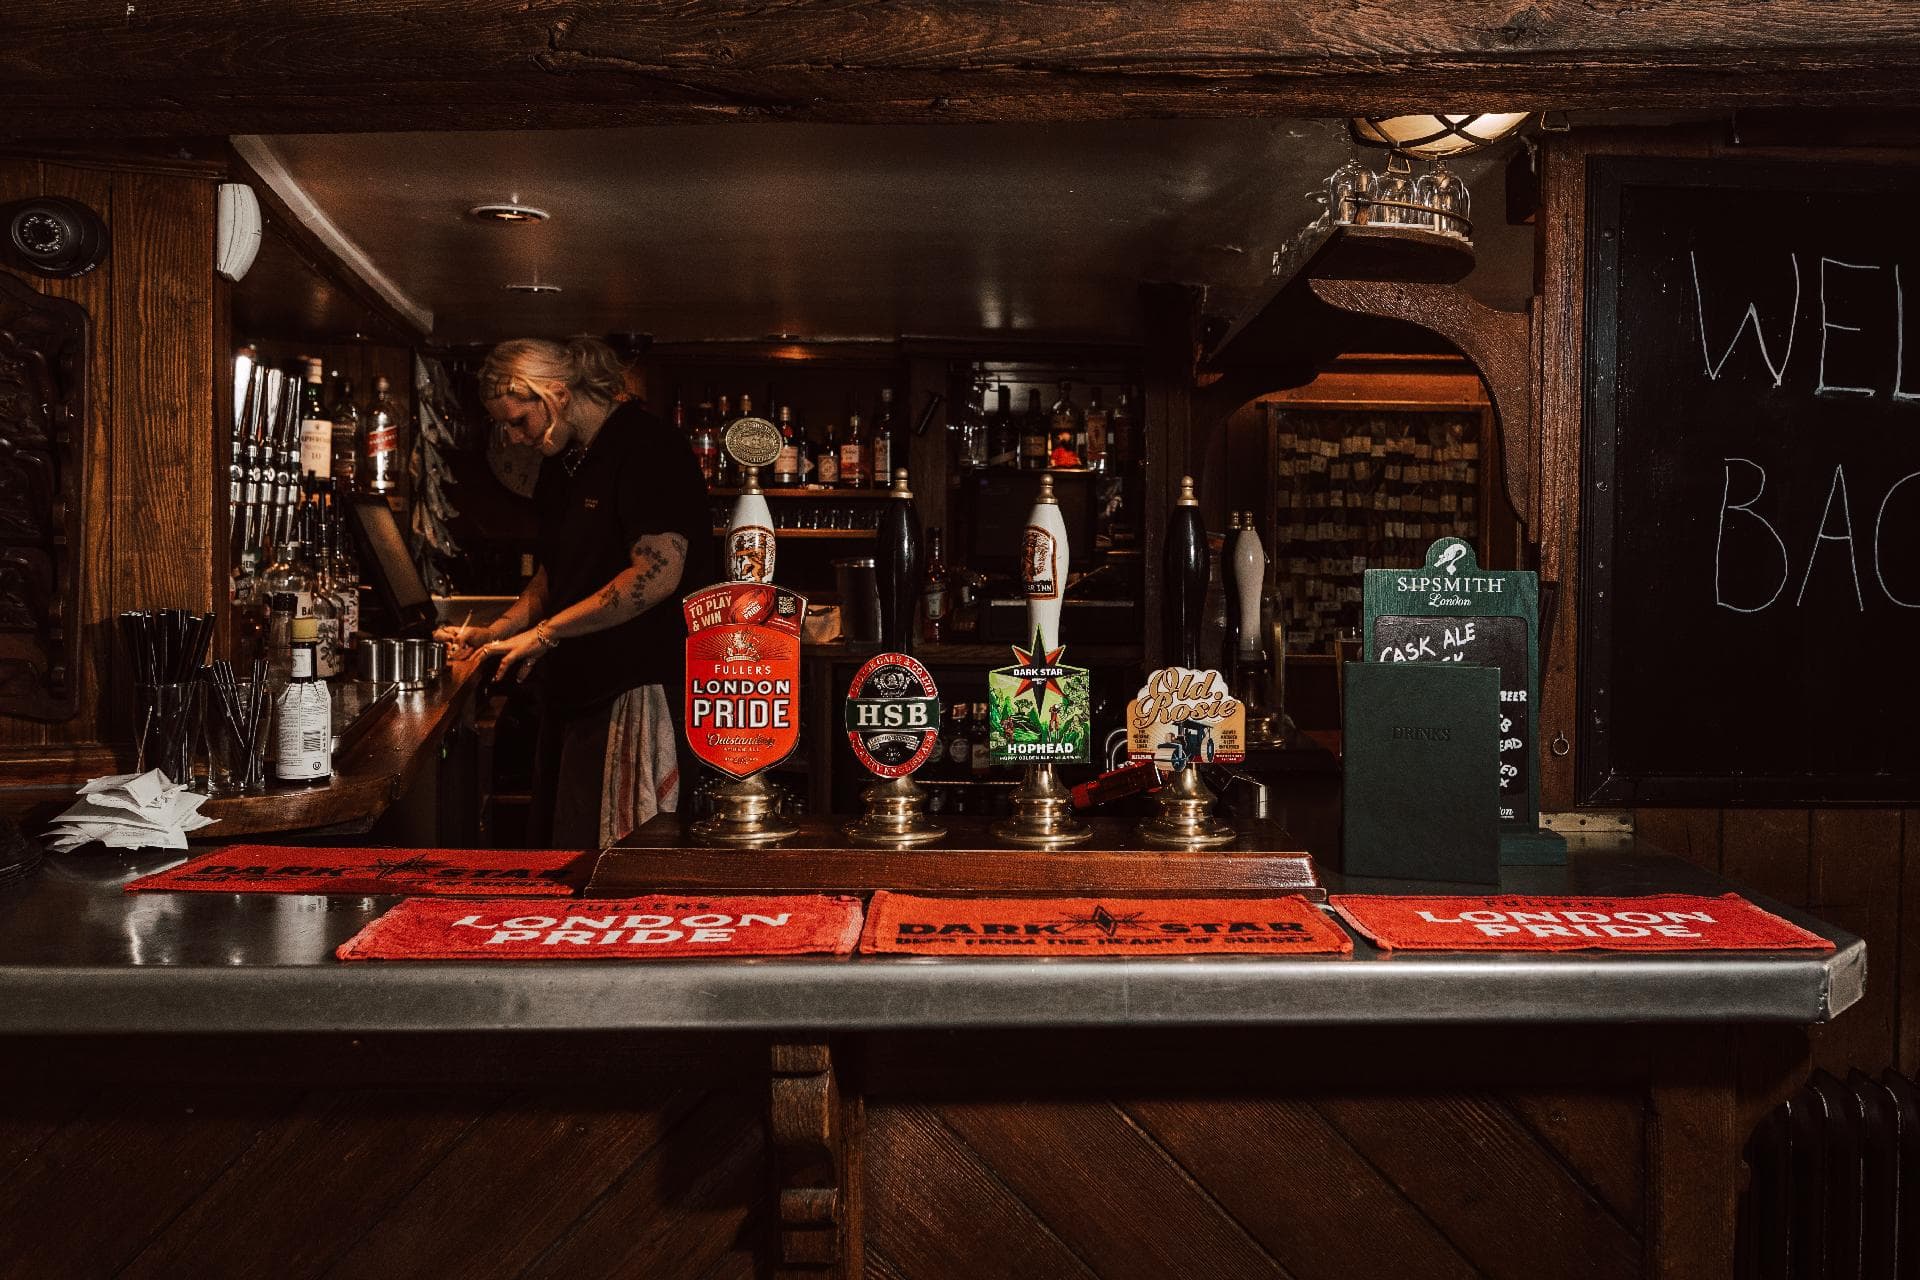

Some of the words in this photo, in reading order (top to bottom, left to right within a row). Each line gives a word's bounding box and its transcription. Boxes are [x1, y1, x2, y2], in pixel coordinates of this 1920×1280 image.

[1397, 577, 1506, 593] SIPSMITH
[689, 605, 704, 619] TO
[706, 595, 733, 612] PLAY
[1428, 593, 1472, 608] London
[743, 604, 763, 621] PRIDE
[692, 620, 700, 632] &
[701, 611, 722, 626] WIN
[1380, 635, 1436, 662] CASK
[1443, 622, 1476, 650] ALE
[1013, 668, 1038, 676] DARK
[1040, 668, 1063, 676] STAR
[693, 679, 790, 695] LONDON
[1149, 667, 1216, 701] Old
[693, 698, 790, 728] PRIDE
[856, 702, 928, 727] HSB
[1133, 691, 1237, 730] Rosie
[1391, 727, 1451, 742] DRINKS
[1007, 742, 1074, 754] HOPHEAD
[195, 865, 352, 876] DARK
[452, 913, 792, 930] LONDON
[1414, 910, 1718, 924] LONDON
[484, 928, 737, 945] PRIDE
[899, 923, 1064, 935] DARK
[1159, 922, 1305, 933] STAR
[1474, 923, 1703, 938] PRIDE
[1098, 937, 1176, 945] HEART
[1184, 937, 1213, 945] OF
[1224, 936, 1314, 945] SUSSEX
